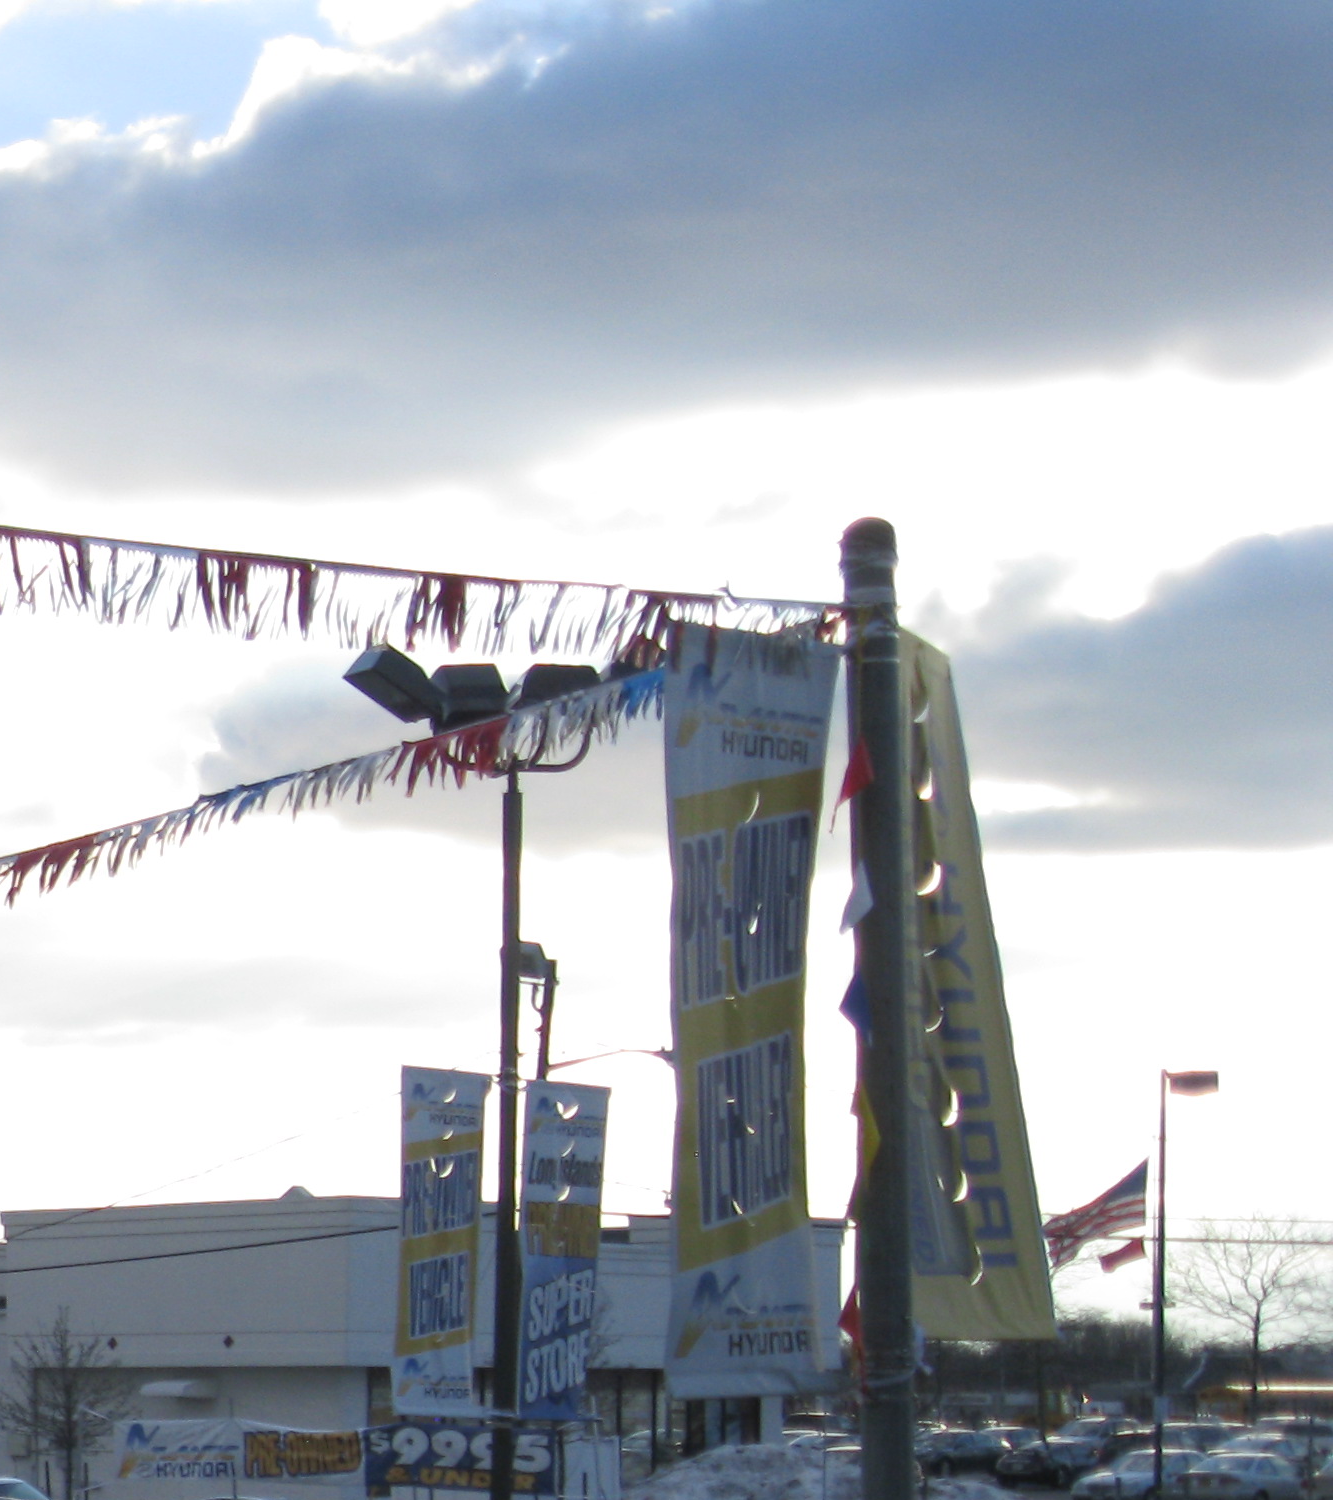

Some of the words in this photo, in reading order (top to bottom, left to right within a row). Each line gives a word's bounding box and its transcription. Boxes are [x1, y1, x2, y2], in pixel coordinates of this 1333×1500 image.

[722, 730, 808, 764] HYUNDAI
[935, 864, 1019, 1269] HYUNDAI
[409, 1253, 469, 1338] VEHICLE
[528, 1269, 593, 1342] SUPER
[156, 1461, 236, 1478] HYUNDAI
[245, 1429, 362, 1477] PRE-OWNED
[419, 1467, 537, 1491] UNDR
